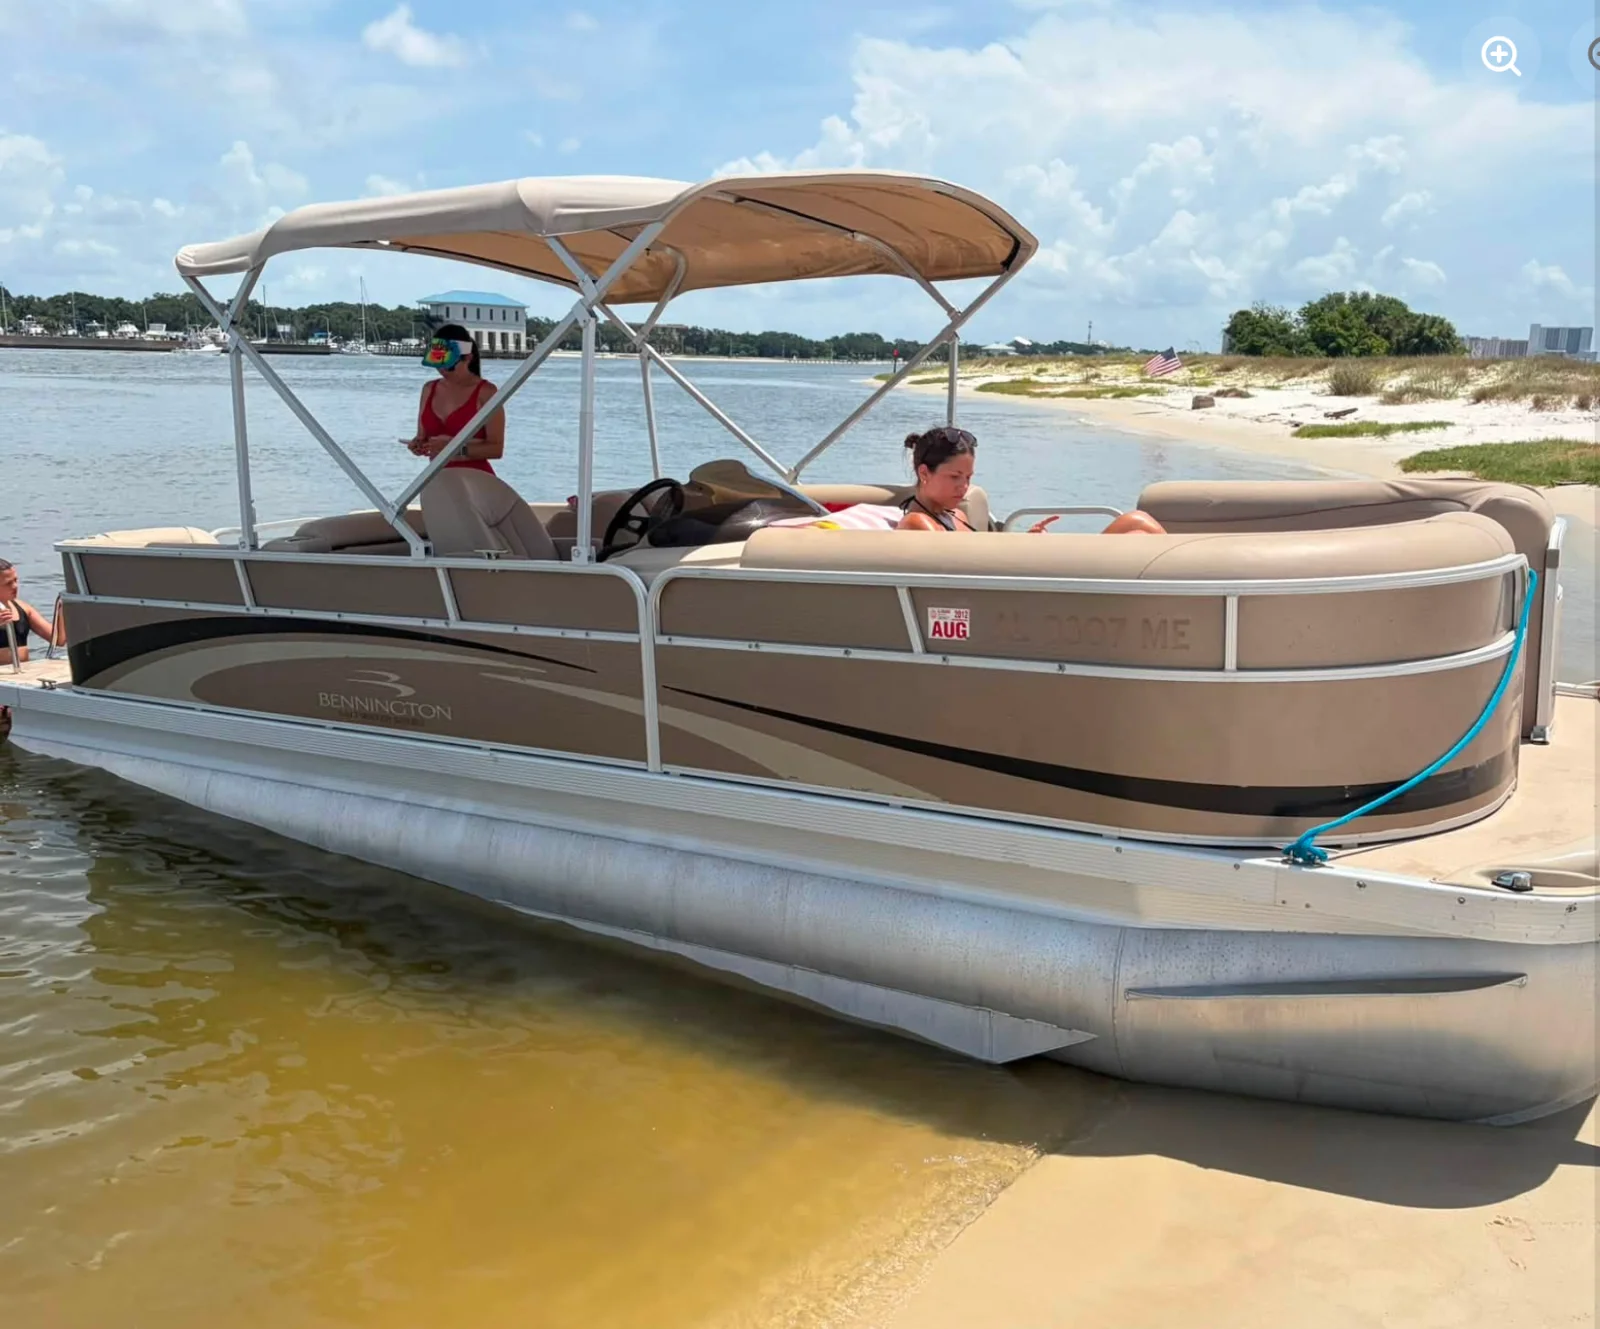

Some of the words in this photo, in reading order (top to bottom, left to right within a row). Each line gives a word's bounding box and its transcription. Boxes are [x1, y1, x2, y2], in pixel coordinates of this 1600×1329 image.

[931, 620, 968, 639] AUG
[1141, 617, 1191, 650] ME
[318, 692, 453, 721] BENNINGTON
